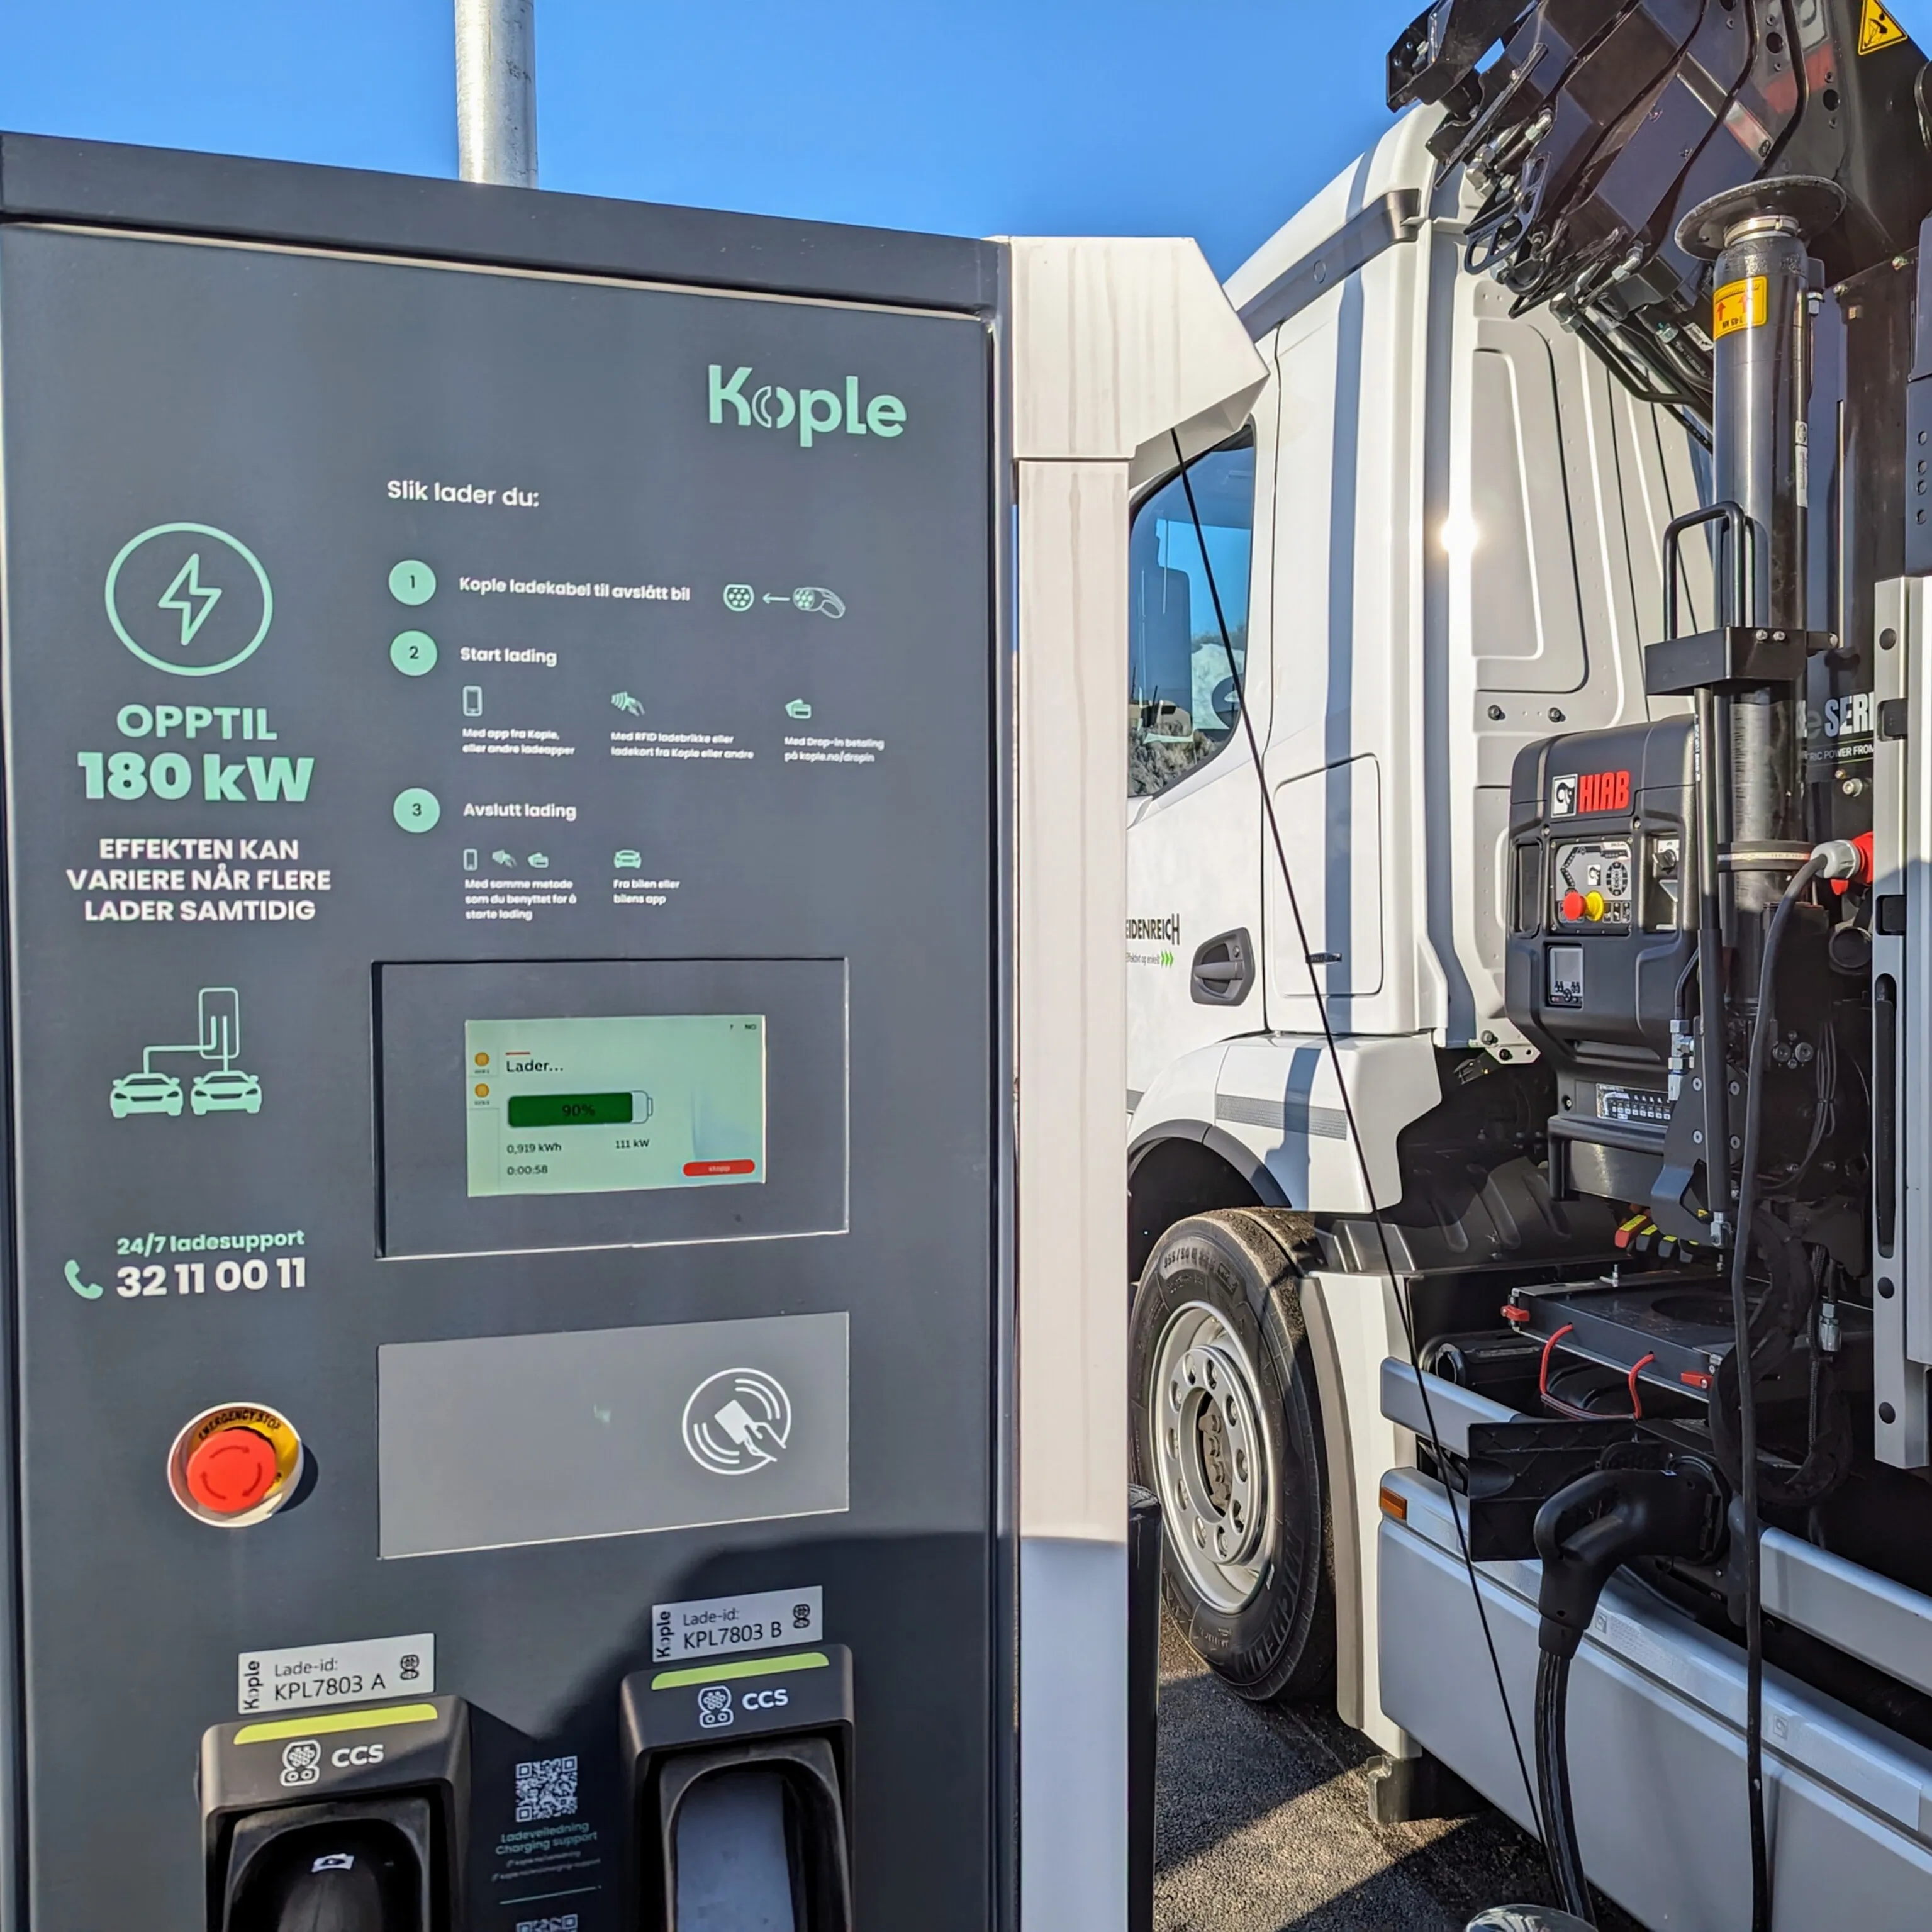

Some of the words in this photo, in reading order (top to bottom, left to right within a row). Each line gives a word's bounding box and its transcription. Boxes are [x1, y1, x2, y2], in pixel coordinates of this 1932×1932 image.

[708, 364, 907, 448] Kople
[388, 479, 428, 500] Slik
[434, 482, 496, 505] lader
[502, 487, 539, 507] du:
[410, 575, 415, 589] 1
[459, 576, 506, 595] Kople
[510, 579, 590, 597] ladekabel
[593, 583, 610, 597] til
[612, 583, 668, 600] avslått
[671, 586, 691, 601] bil
[409, 645, 419, 659] 2
[460, 647, 501, 661] Start
[505, 648, 557, 667] lading
[116, 703, 277, 740] OPPTIL
[462, 728, 486, 738] Med
[488, 730, 510, 740] app
[510, 729, 526, 739] fra
[611, 732, 633, 742] Med
[635, 732, 657, 742] RFID
[659, 733, 710, 744] ladebrikke
[712, 735, 734, 744] eller
[785, 736, 805, 747] Med
[807, 737, 844, 749] Drop-in
[845, 738, 885, 751] betaling
[462, 744, 486, 754] eller
[488, 744, 519, 754] andre
[521, 744, 575, 757] ladeapper
[611, 746, 654, 757] ladekort
[655, 747, 670, 757] fra
[671, 748, 700, 760] Kople
[701, 749, 723, 759] eller
[723, 749, 754, 759] andre
[785, 751, 797, 762] på
[77, 751, 192, 800] 180
[203, 753, 315, 802] kW
[1578, 770, 1630, 814] HIAB
[412, 803, 422, 817] 3
[463, 803, 522, 818] Avslutt
[525, 803, 576, 822] lading
[99, 838, 233, 860] EFFEKTEN
[240, 839, 299, 860] KAN
[66, 869, 185, 890] VARIERE
[191, 863, 250, 890] NÅR
[257, 869, 331, 890] FLERE
[465, 879, 488, 889] Med
[490, 879, 530, 889] samme
[532, 879, 573, 889] metode
[613, 879, 631, 889] Fra
[632, 879, 657, 889] bilen
[658, 879, 681, 889] eller
[465, 895, 488, 905] som
[490, 894, 505, 905] du
[506, 894, 551, 906] benyttet
[552, 894, 567, 905] for
[613, 894, 644, 904] bilens
[646, 895, 666, 905] app
[84, 900, 174, 921] LADER
[180, 900, 316, 921] SAMTIDIG
[466, 909, 497, 920] starte
[499, 909, 533, 922] lading
[506, 1059, 564, 1073] Lader...
[561, 1103, 596, 1118] 90%
[538, 1142, 562, 1153] kWh
[615, 1139, 630, 1150] 111
[633, 1139, 650, 1149] kW
[506, 1164, 549, 1176] 0:00:58
[116, 1232, 166, 1257] 24/7
[170, 1229, 305, 1253] ladesupport
[116, 1265, 167, 1298] 32
[174, 1263, 205, 1295] 11
[215, 1259, 269, 1292] 00
[276, 1257, 306, 1288] 11
[256, 1411, 281, 1430] STOP
[683, 1607, 739, 1626] Lade-id:
[656, 1611, 675, 1658] Kople
[684, 1624, 763, 1650] KPL7803
[771, 1621, 782, 1638] B
[274, 1658, 338, 1678] Lade-id:
[243, 1660, 263, 1711] Kople
[274, 1675, 364, 1701] KPL7803
[371, 1673, 386, 1690] A
[742, 1689, 788, 1711] CCS
[331, 1743, 384, 1768] CCS
[495, 1839, 550, 1855] Charging
[552, 1831, 598, 1847] support
